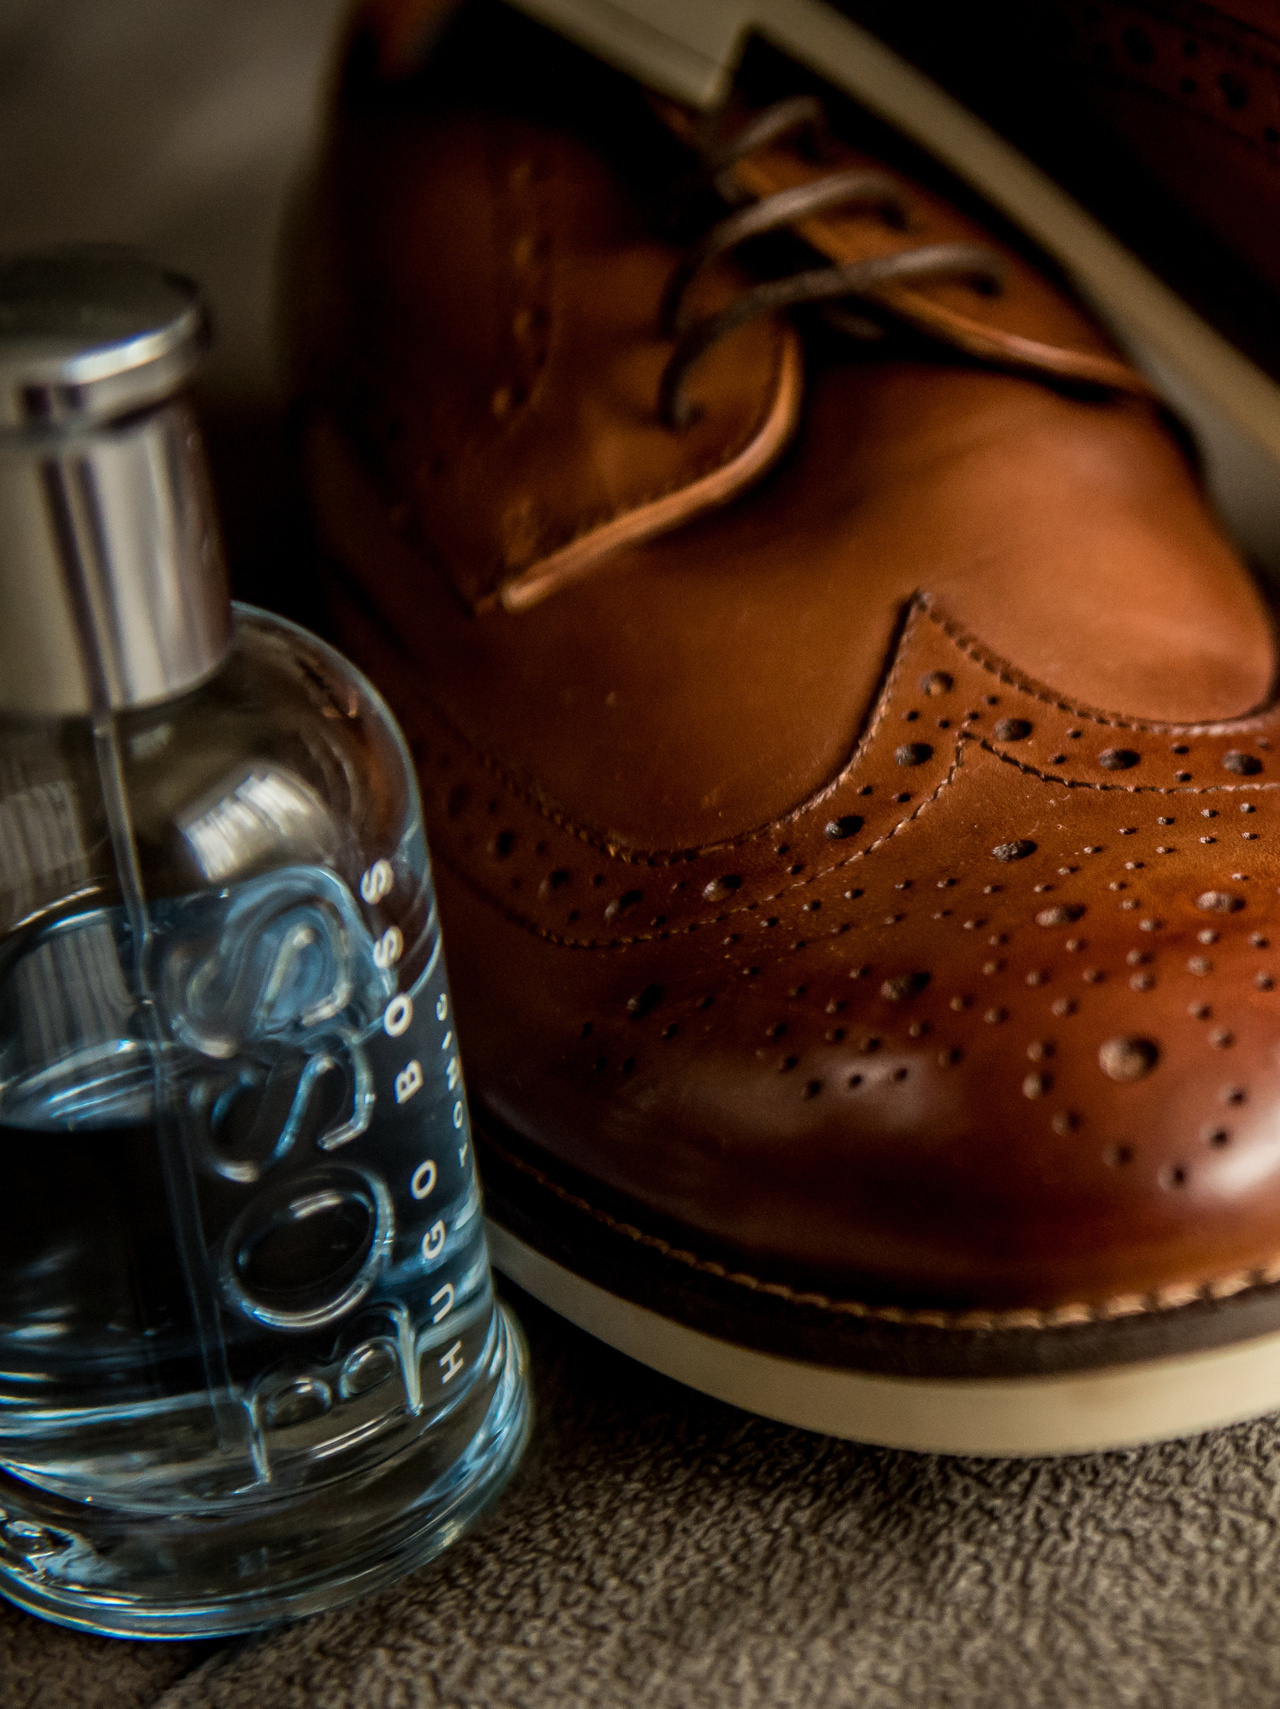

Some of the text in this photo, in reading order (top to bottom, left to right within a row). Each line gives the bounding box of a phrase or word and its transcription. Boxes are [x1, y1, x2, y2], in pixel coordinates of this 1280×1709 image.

[168, 868, 422, 1490] BOSS
[361, 859, 463, 1385] HUGO BOSS
[436, 993, 468, 1167] TONIC
